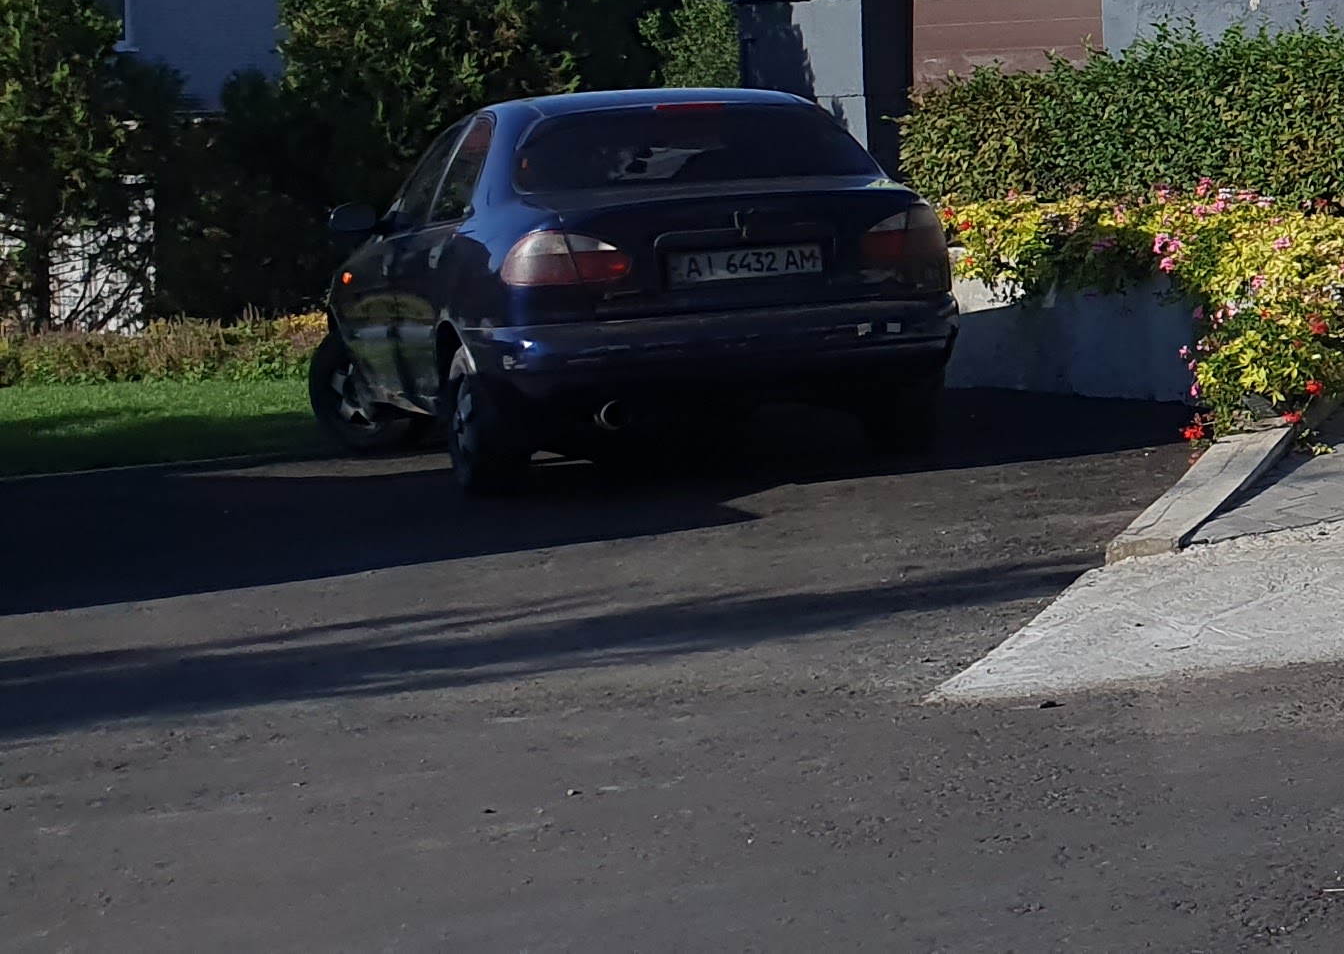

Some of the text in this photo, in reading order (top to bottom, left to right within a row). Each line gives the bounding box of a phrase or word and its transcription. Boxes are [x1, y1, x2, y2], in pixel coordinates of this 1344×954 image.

[686, 249, 819, 278] AI 6432 AM
